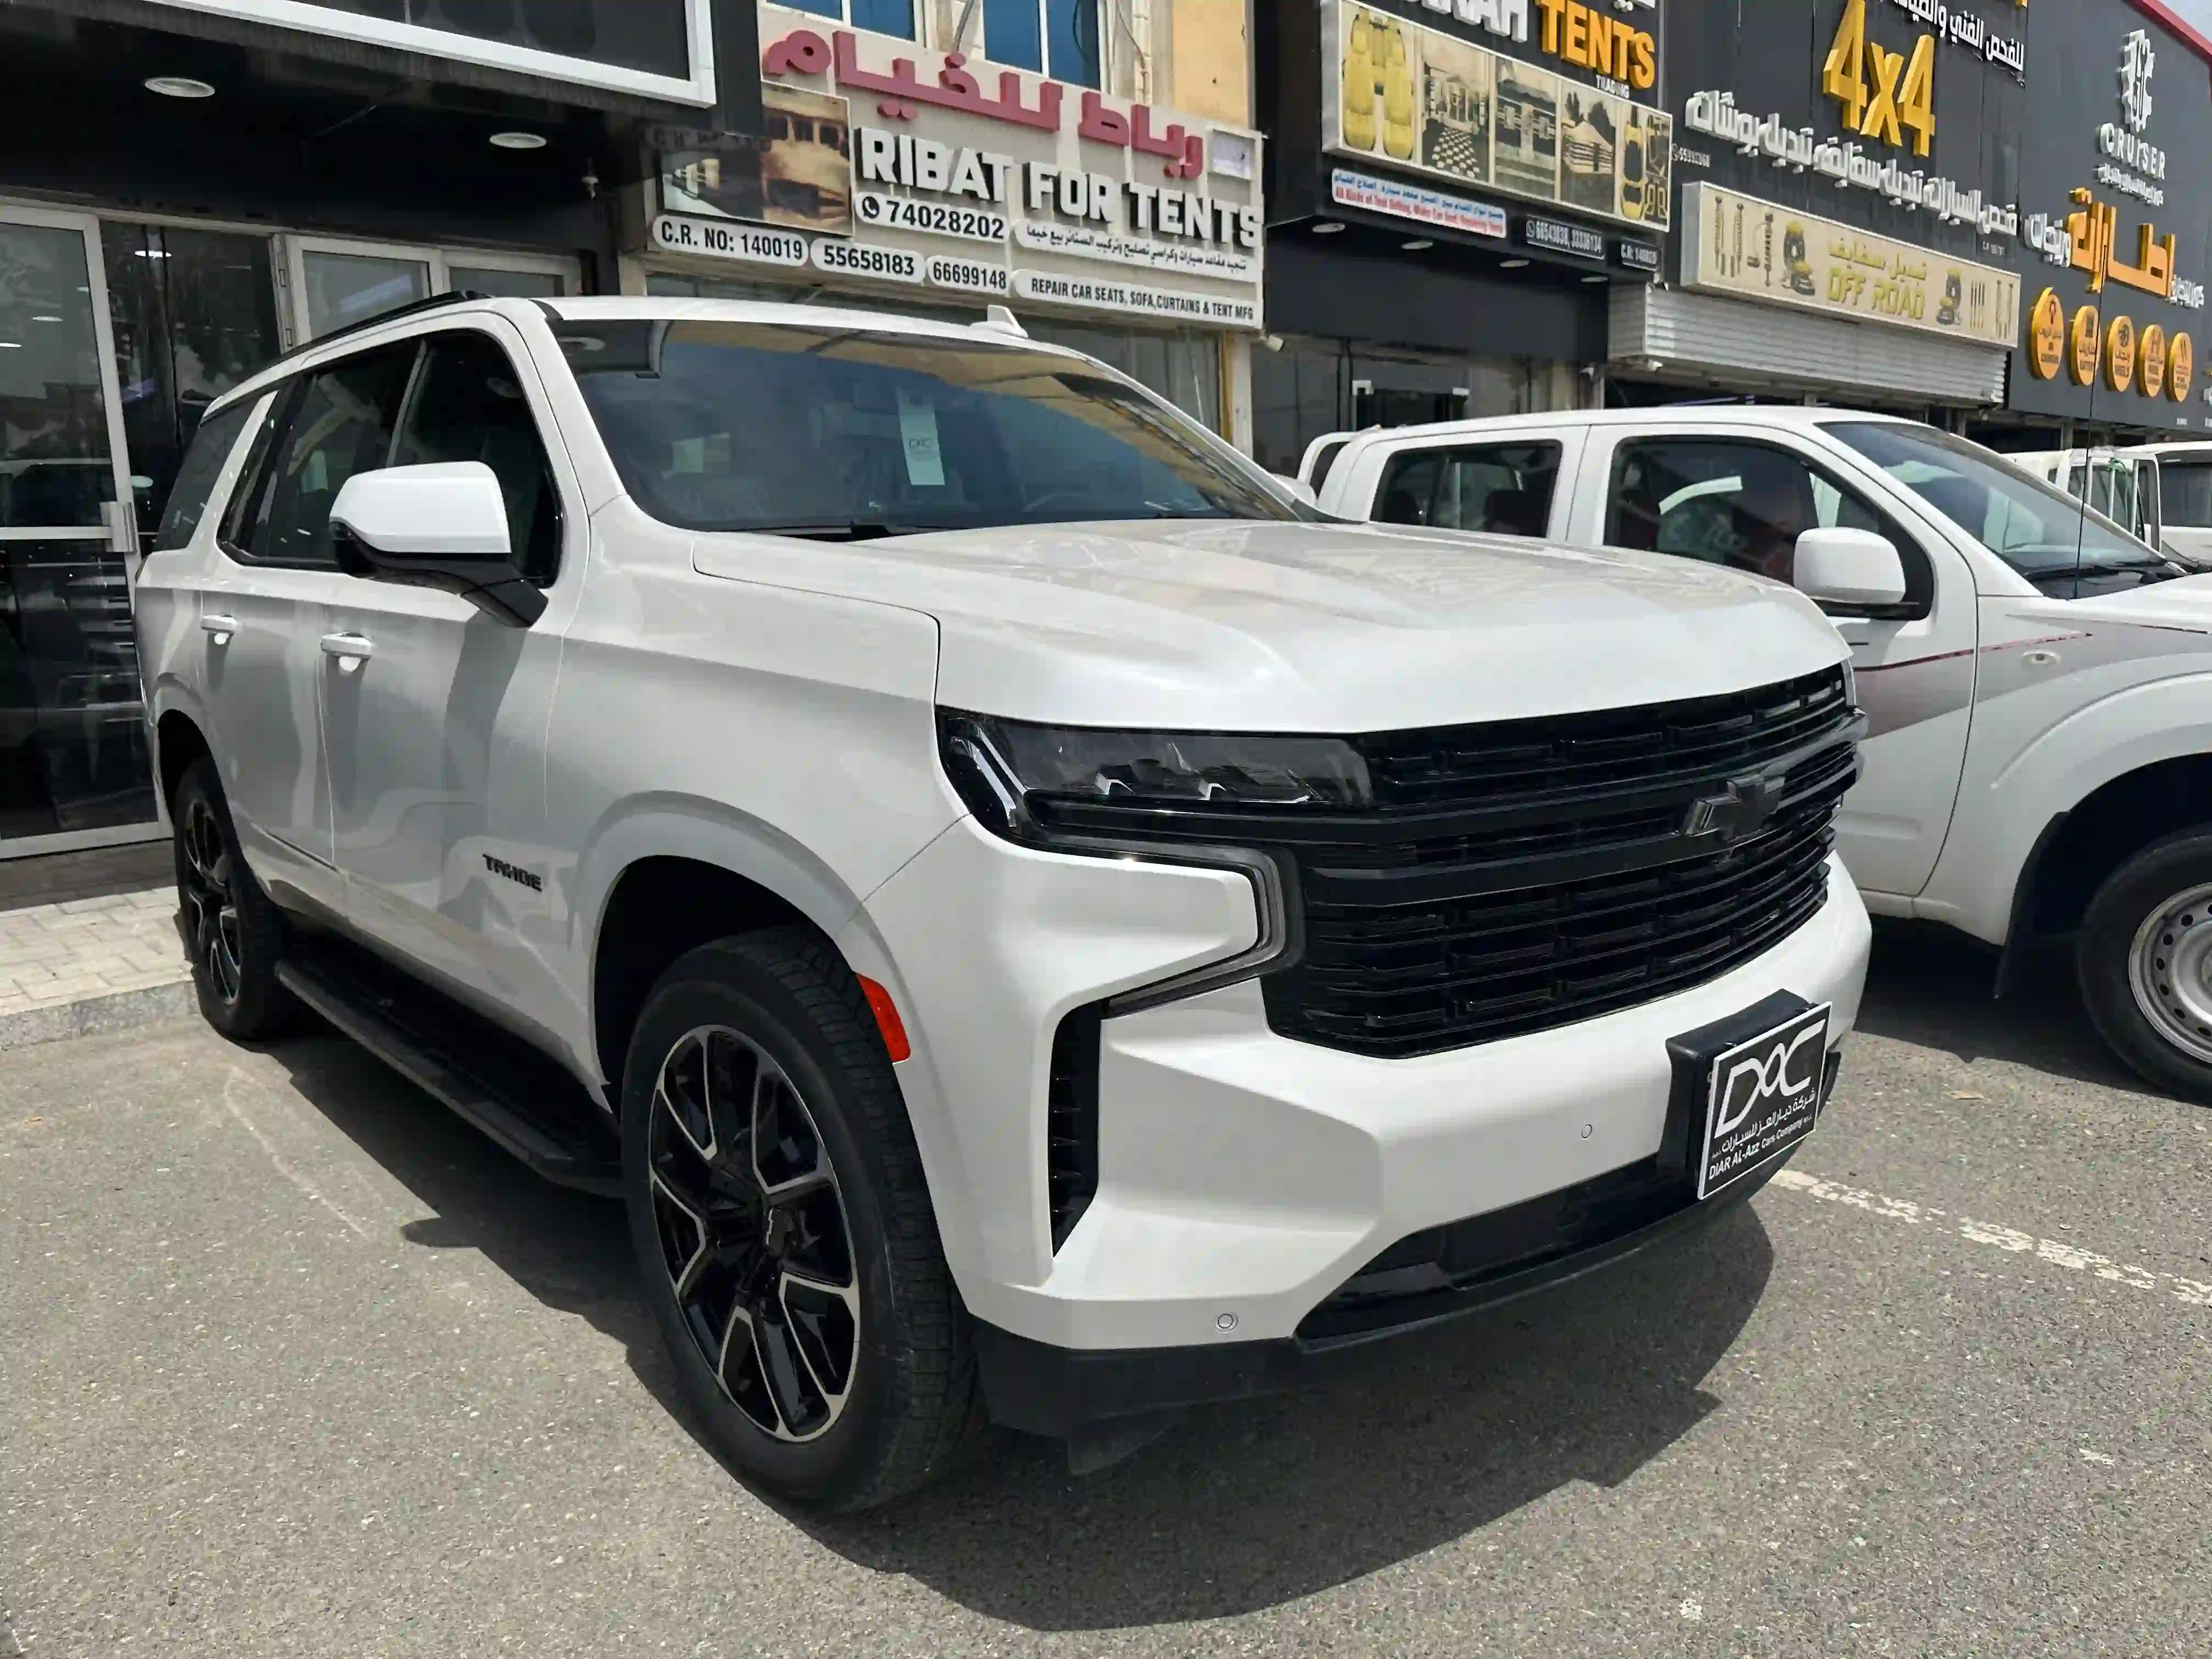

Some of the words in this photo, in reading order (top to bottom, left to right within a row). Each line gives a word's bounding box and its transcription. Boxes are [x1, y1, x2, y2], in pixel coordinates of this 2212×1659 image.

[1534, 0, 1655, 89] TENTS
[1077, 91, 1204, 179] رباط
[2100, 123, 2165, 180] CRUISER
[854, 127, 1012, 202] RIBAT
[1028, 161, 1115, 223] FOR
[1123, 181, 1264, 248] TENTS
[661, 222, 698, 247] C.R.
[705, 228, 734, 253] NO:
[741, 233, 803, 259] 140019
[886, 200, 1004, 240] 74028202
[823, 244, 914, 276] 55658183
[932, 261, 1007, 290] 66699148
[1031, 278, 1068, 297] REPAIR
[1072, 284, 1092, 300] CAR
[1202, 304, 1209, 315] &
[1211, 302, 1233, 317] TENT
[1235, 305, 1254, 320] MFG
[1829, 267, 1866, 306] OFF
[1870, 277, 1926, 320] ROAD
[1709, 1156, 1731, 1180] DIAR
[1761, 1135, 1775, 1149] Cars
[1776, 1118, 1803, 1140] Company
